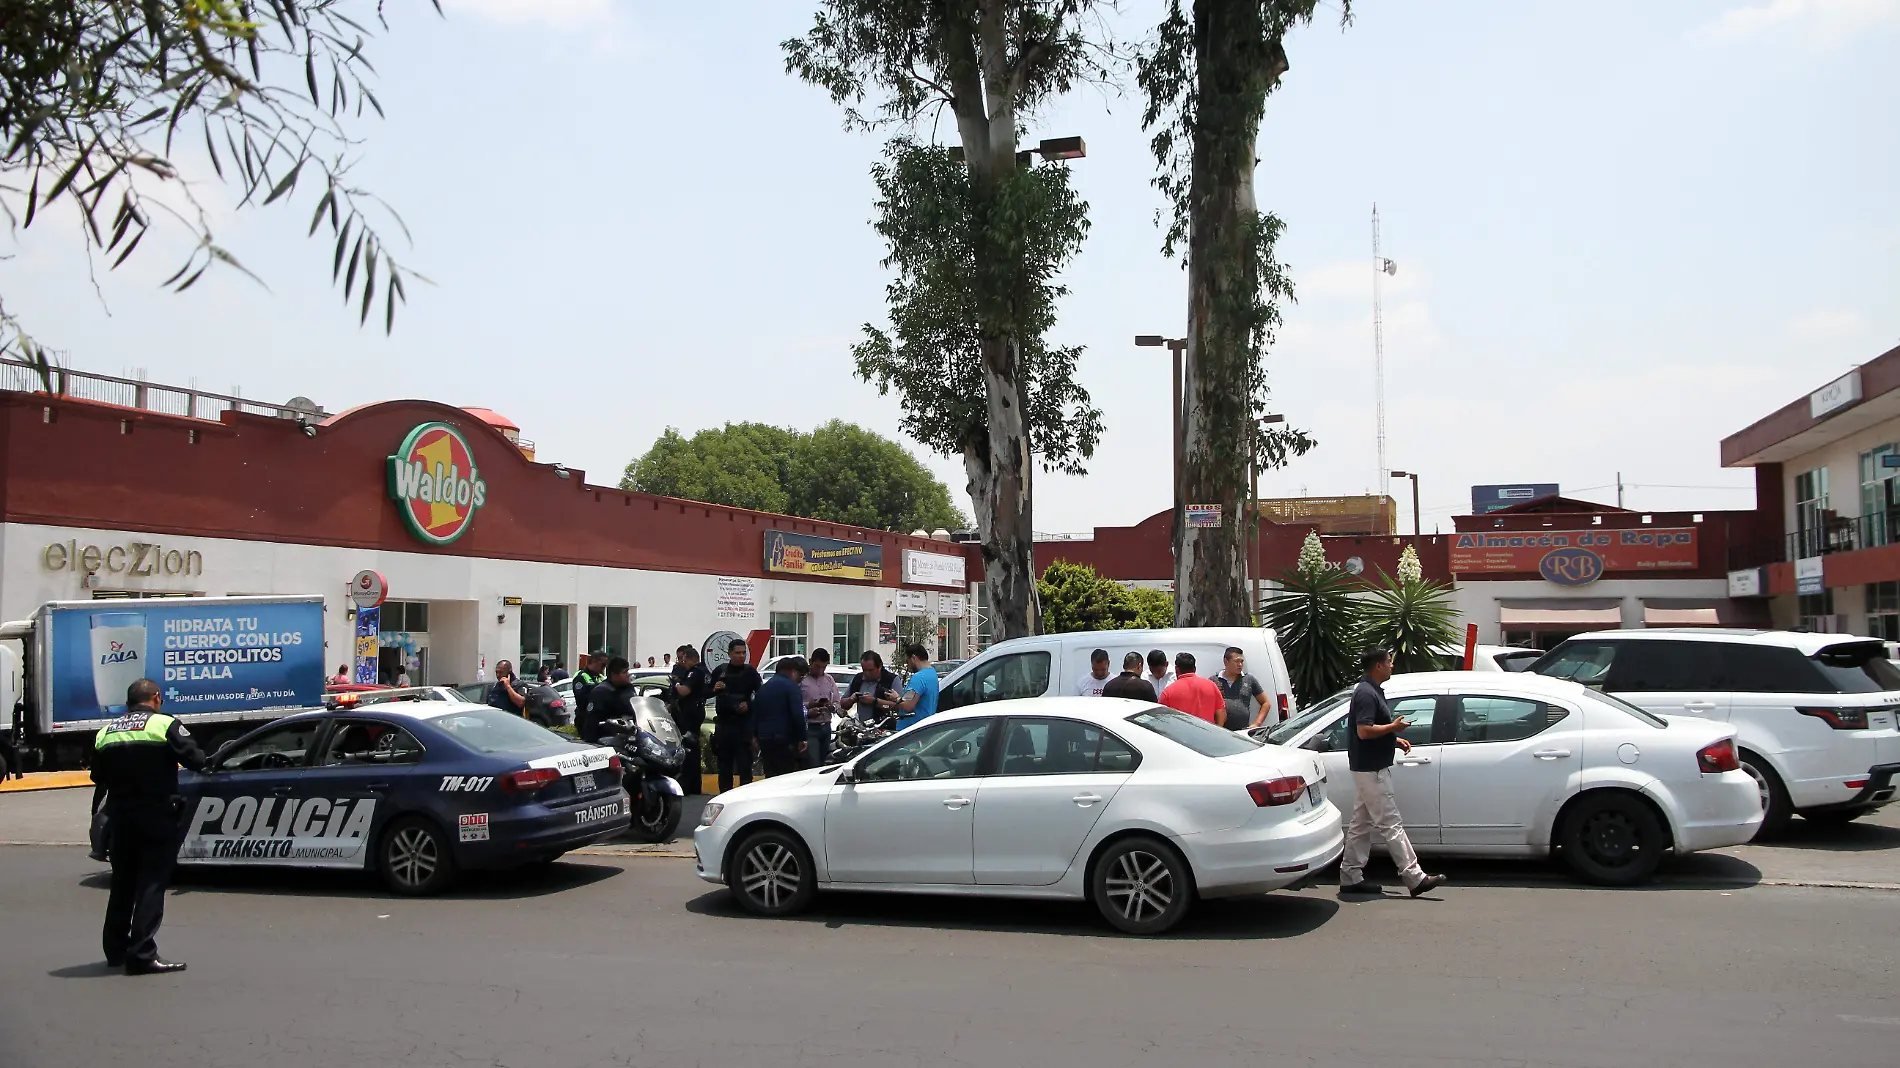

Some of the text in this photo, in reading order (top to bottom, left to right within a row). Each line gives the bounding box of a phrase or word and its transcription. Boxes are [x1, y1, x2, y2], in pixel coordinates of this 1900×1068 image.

[395, 458, 485, 506] Waldo's
[1456, 530, 1691, 548] Almacén de Ropa
[164, 617, 258, 632] HIDRATA TU
[165, 632, 302, 648] CUERPO CON LOS
[101, 650, 138, 665] LALA
[164, 648, 282, 665] ELECTROLITOS
[165, 665, 233, 681] DE LALA
[175, 692, 203, 702] SÚMALE
[204, 693, 215, 701] UN
[283, 689, 295, 697] DÍA
[557, 756, 583, 770] POLICÍA
[439, 776, 494, 792] TM-017
[186, 796, 377, 838] POLICÍA
[461, 815, 486, 825] 911
[575, 803, 619, 824] TRÁNSITO
[211, 837, 344, 858] TRÁNSITO MUNICIPAL
